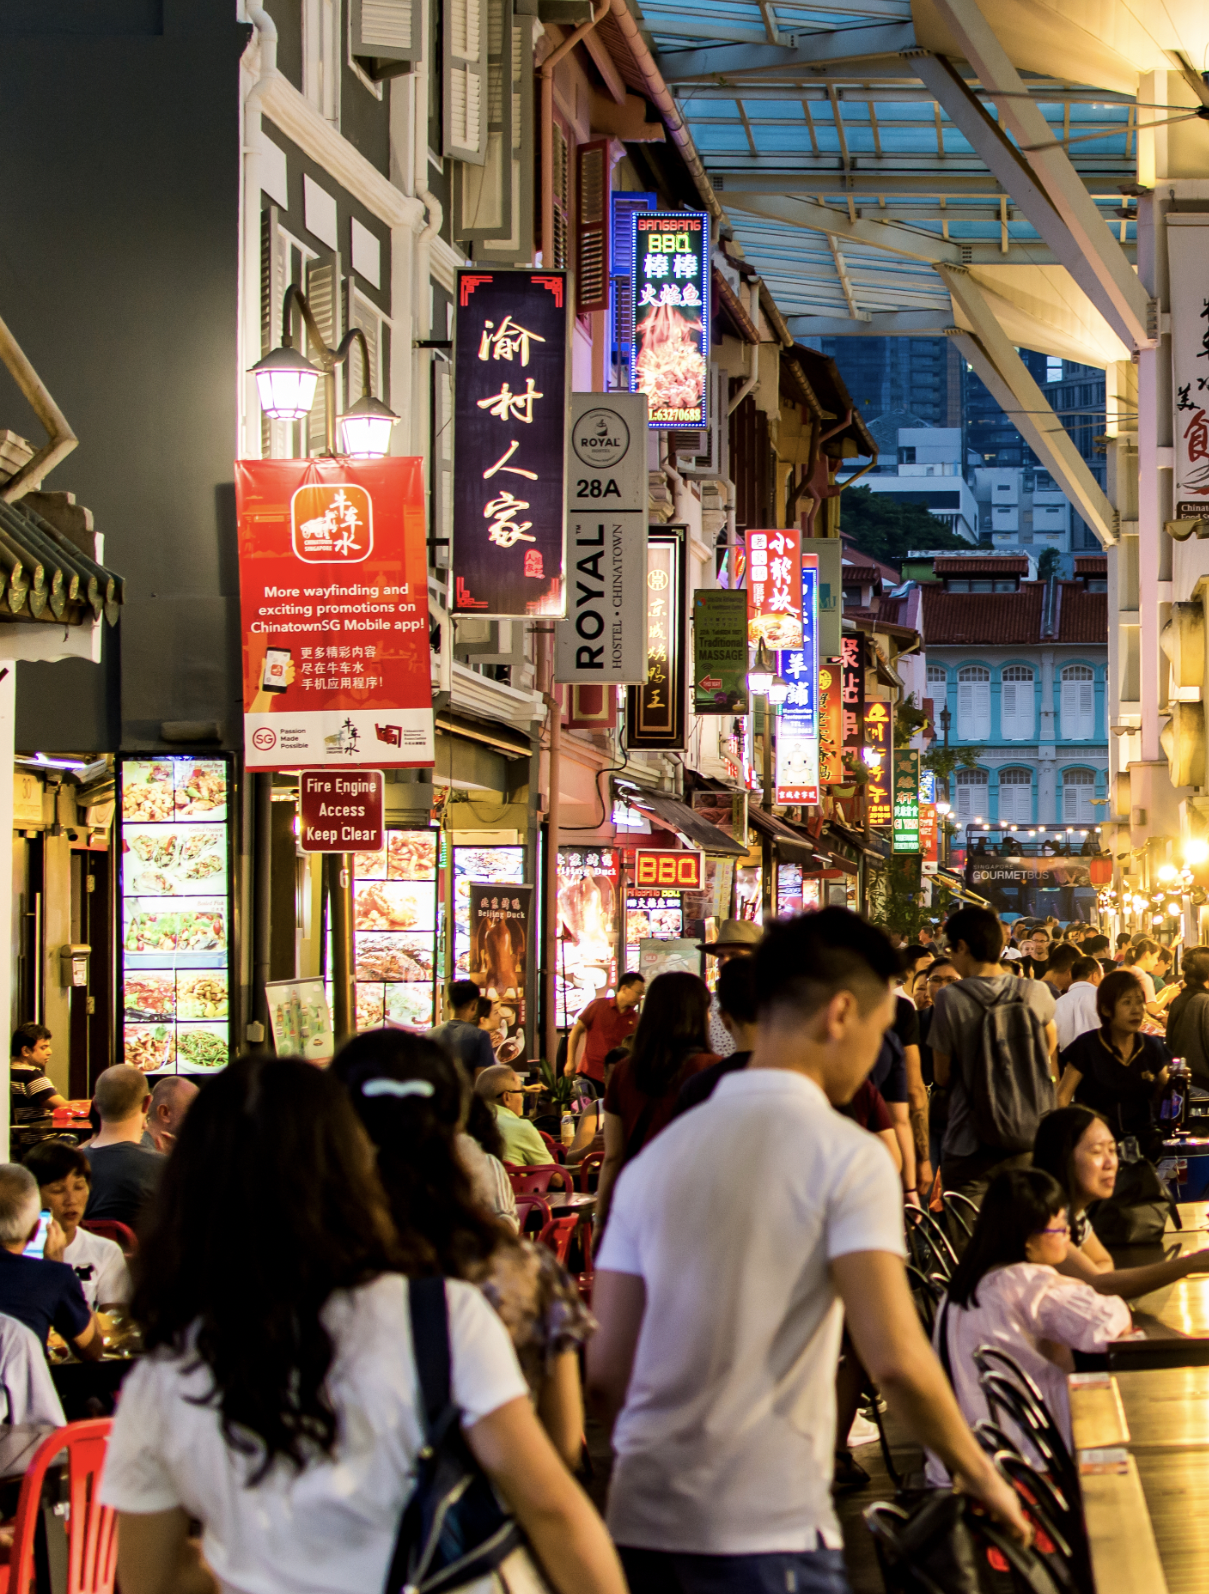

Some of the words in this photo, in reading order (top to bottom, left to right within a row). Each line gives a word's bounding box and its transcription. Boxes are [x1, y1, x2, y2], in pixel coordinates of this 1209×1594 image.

[638, 219, 701, 231] BANGBANG
[648, 234, 692, 253] BBQ
[643, 254, 698, 279] 棒棒
[581, 438, 620, 447] ROYAL
[576, 479, 621, 498] 28A
[612, 524, 623, 608] CHINATOWN
[264, 586, 300, 598] More
[303, 584, 379, 599] wayfinding
[383, 583, 409, 595] and
[576, 524, 605, 670] ROYAL
[258, 602, 312, 617] exciting
[316, 602, 395, 616] promotions
[398, 603, 416, 612] on
[250, 620, 341, 633] ChinatownSG
[344, 619, 391, 632] Mobile
[394, 618, 424, 631] app!
[612, 620, 623, 669] HOSTEL
[699, 637, 743, 648] Traditional
[300, 645, 377, 660] 更多精彩内容
[699, 650, 743, 660] MASSAGE
[300, 661, 364, 675] 尽在牛车水
[255, 734, 273, 744] SG
[306, 778, 331, 792] Fire
[335, 778, 377, 796] Engine
[319, 802, 365, 817] Access
[306, 827, 338, 844] Keep
[341, 827, 377, 841] Clear
[594, 868, 617, 876] Duck
[639, 857, 698, 884] BBQ
[972, 870, 1050, 880] GOURMETBUS
[478, 909, 504, 920] Beijing
[506, 910, 525, 919] Duck
